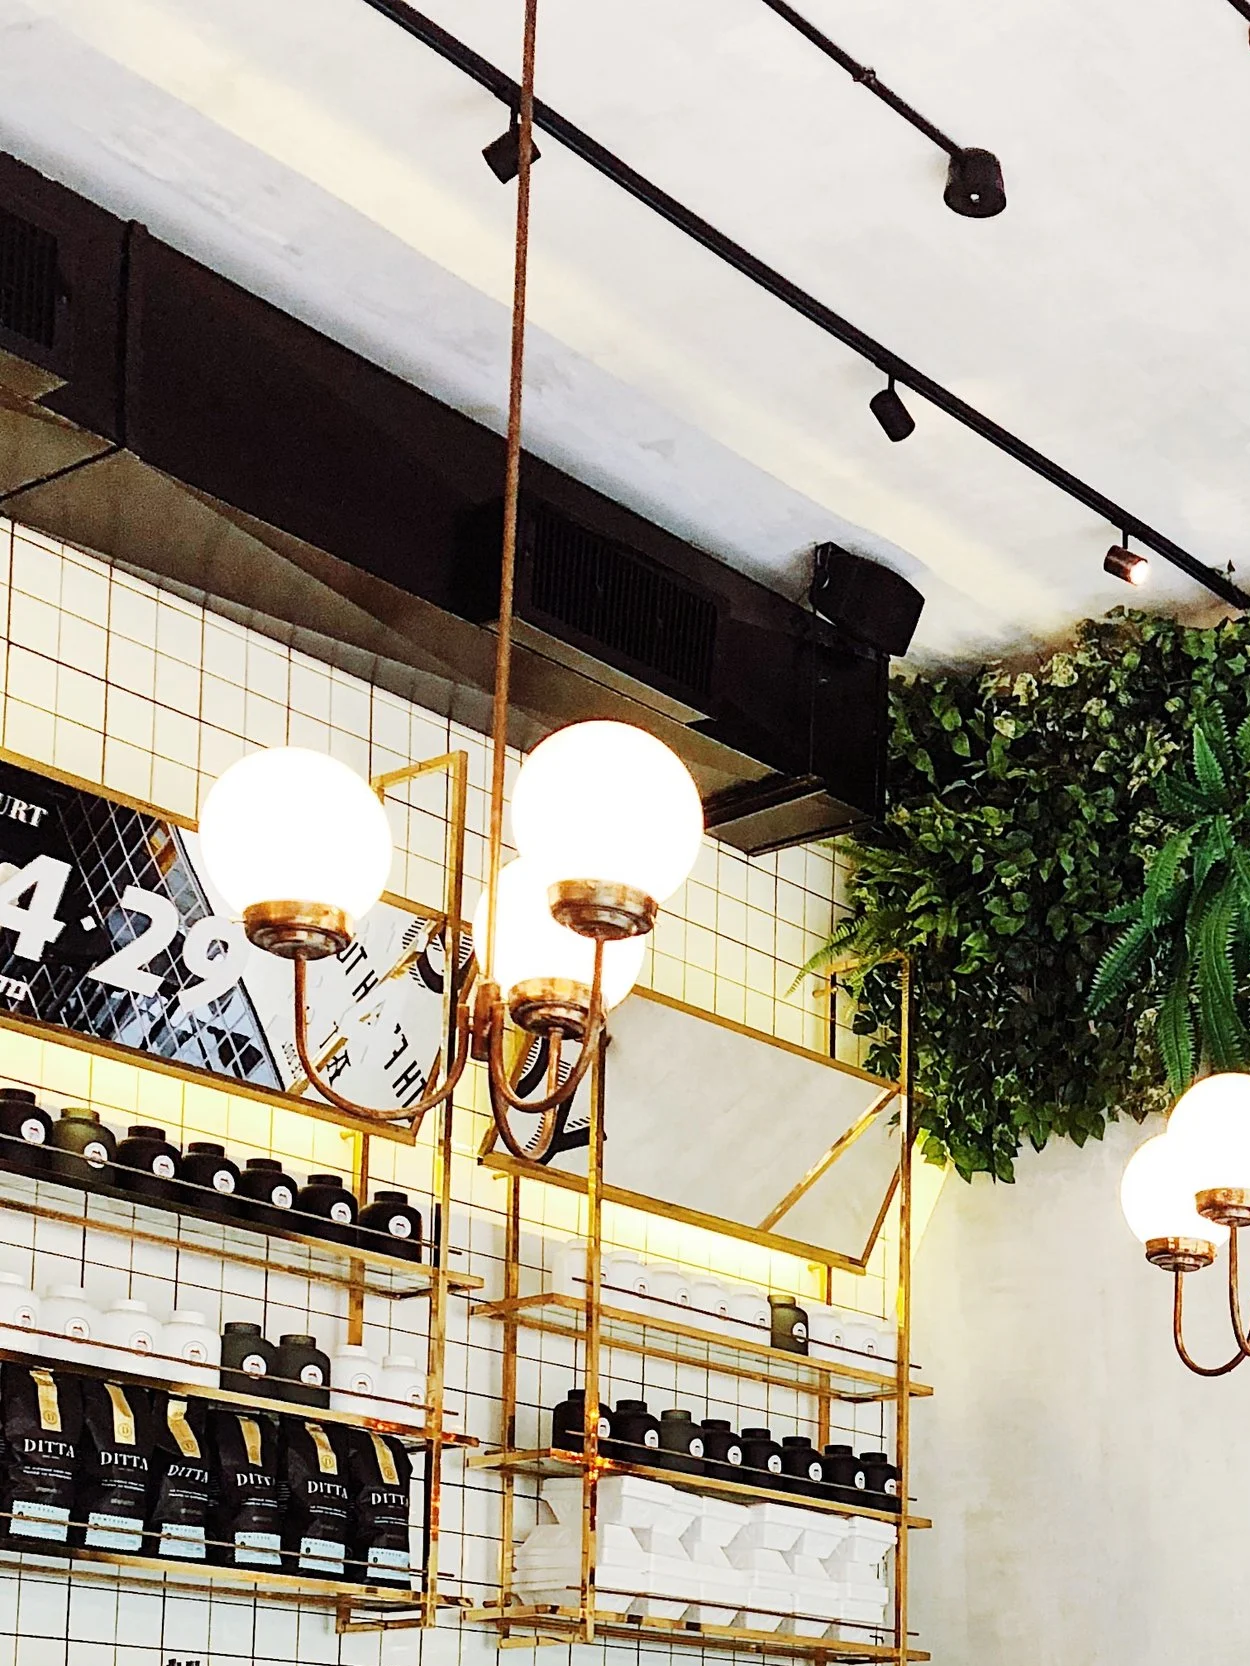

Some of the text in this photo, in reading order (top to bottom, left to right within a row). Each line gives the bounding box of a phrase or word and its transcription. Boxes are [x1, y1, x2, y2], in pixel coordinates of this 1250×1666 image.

[24, 1438, 75, 1459] DITTA
[100, 1451, 149, 1471] DITTA
[307, 1480, 348, 1500] DITTA
[371, 1492, 409, 1507] DITT
